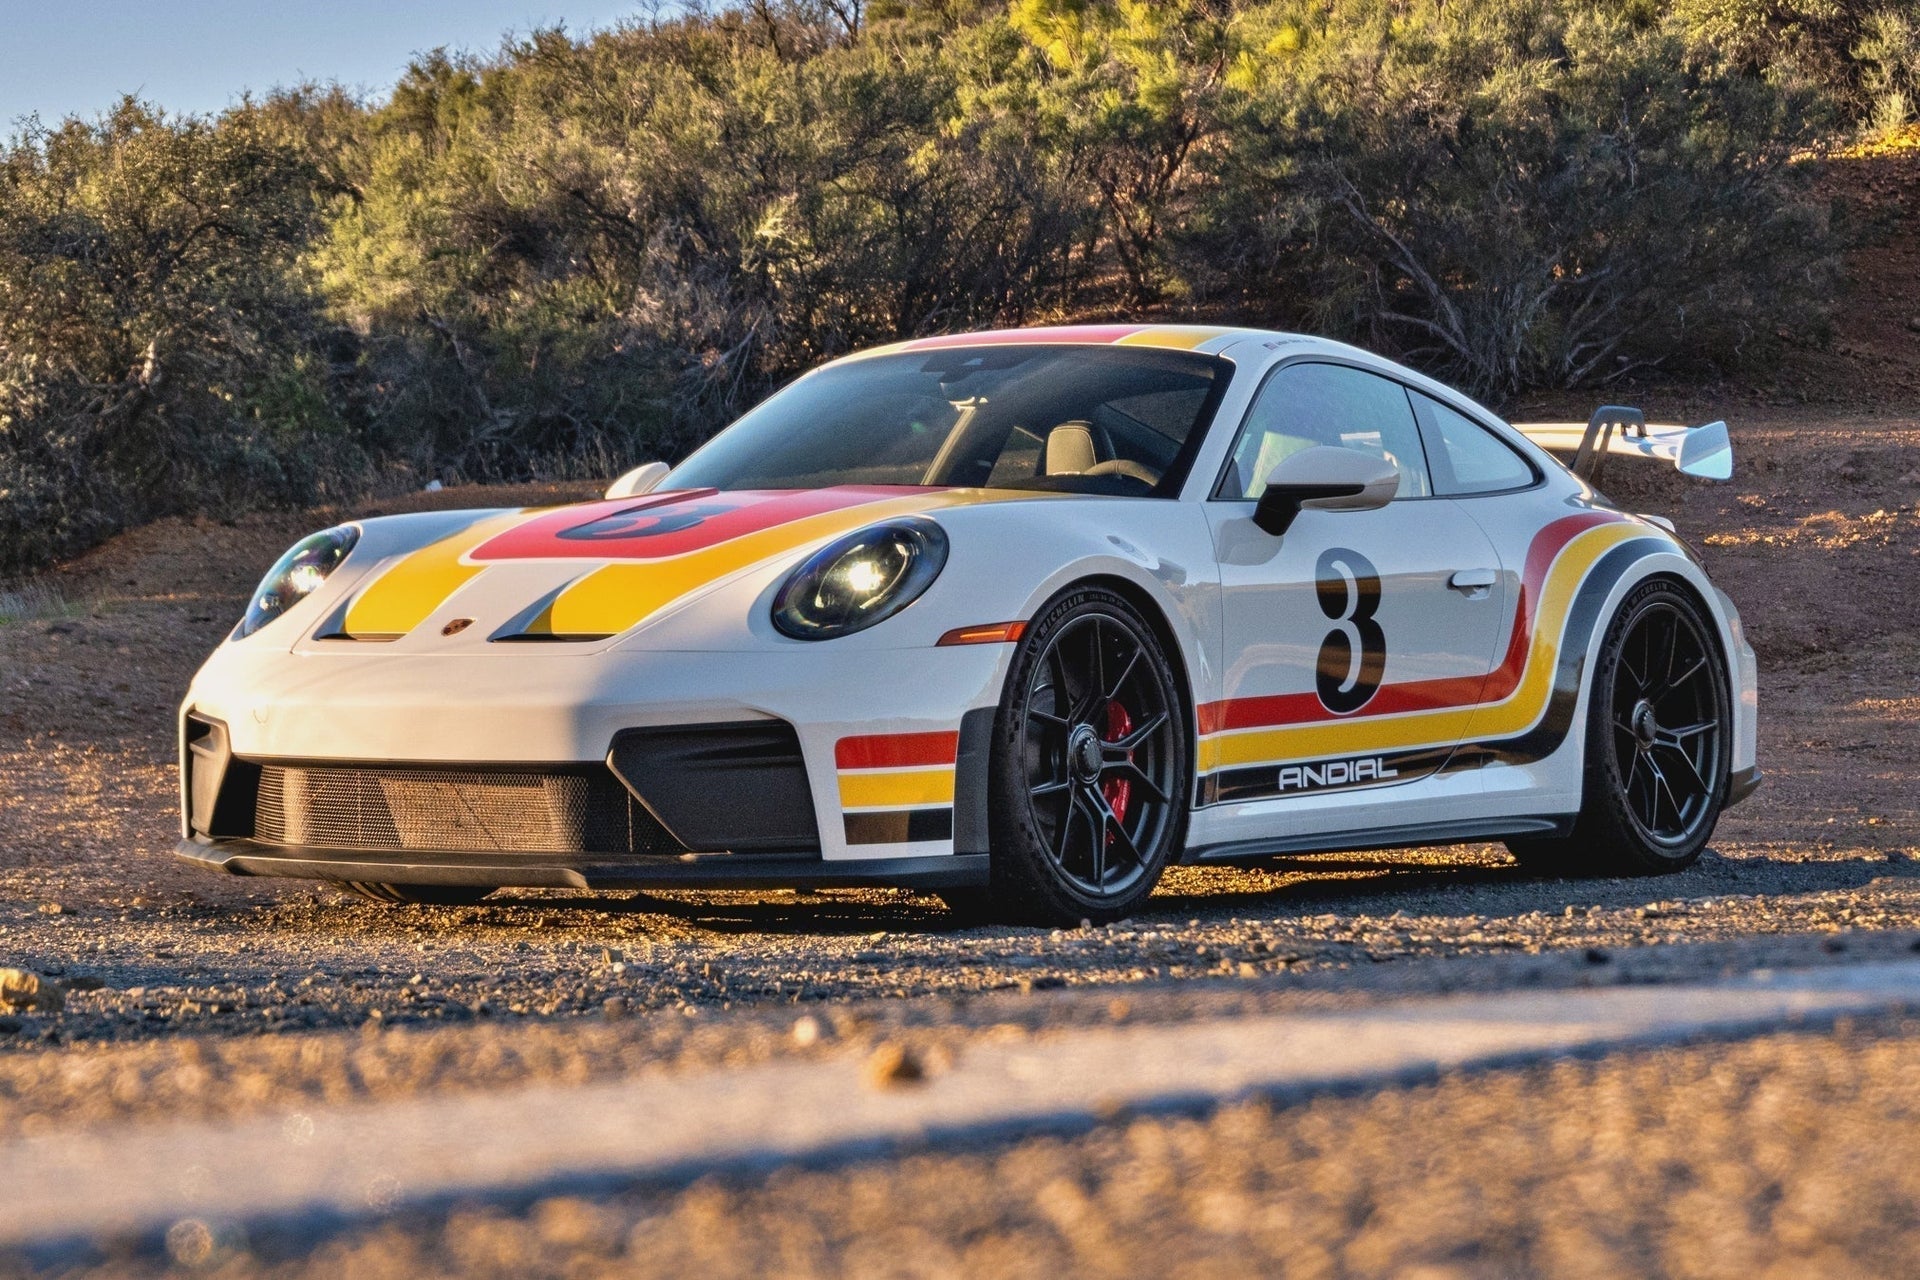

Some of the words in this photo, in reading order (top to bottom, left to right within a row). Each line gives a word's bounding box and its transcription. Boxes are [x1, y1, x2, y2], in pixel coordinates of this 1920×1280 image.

[1039, 594, 1085, 637] MICHELIN
[1315, 547, 1387, 714] 3
[1278, 758, 1398, 791] ANDIAL
